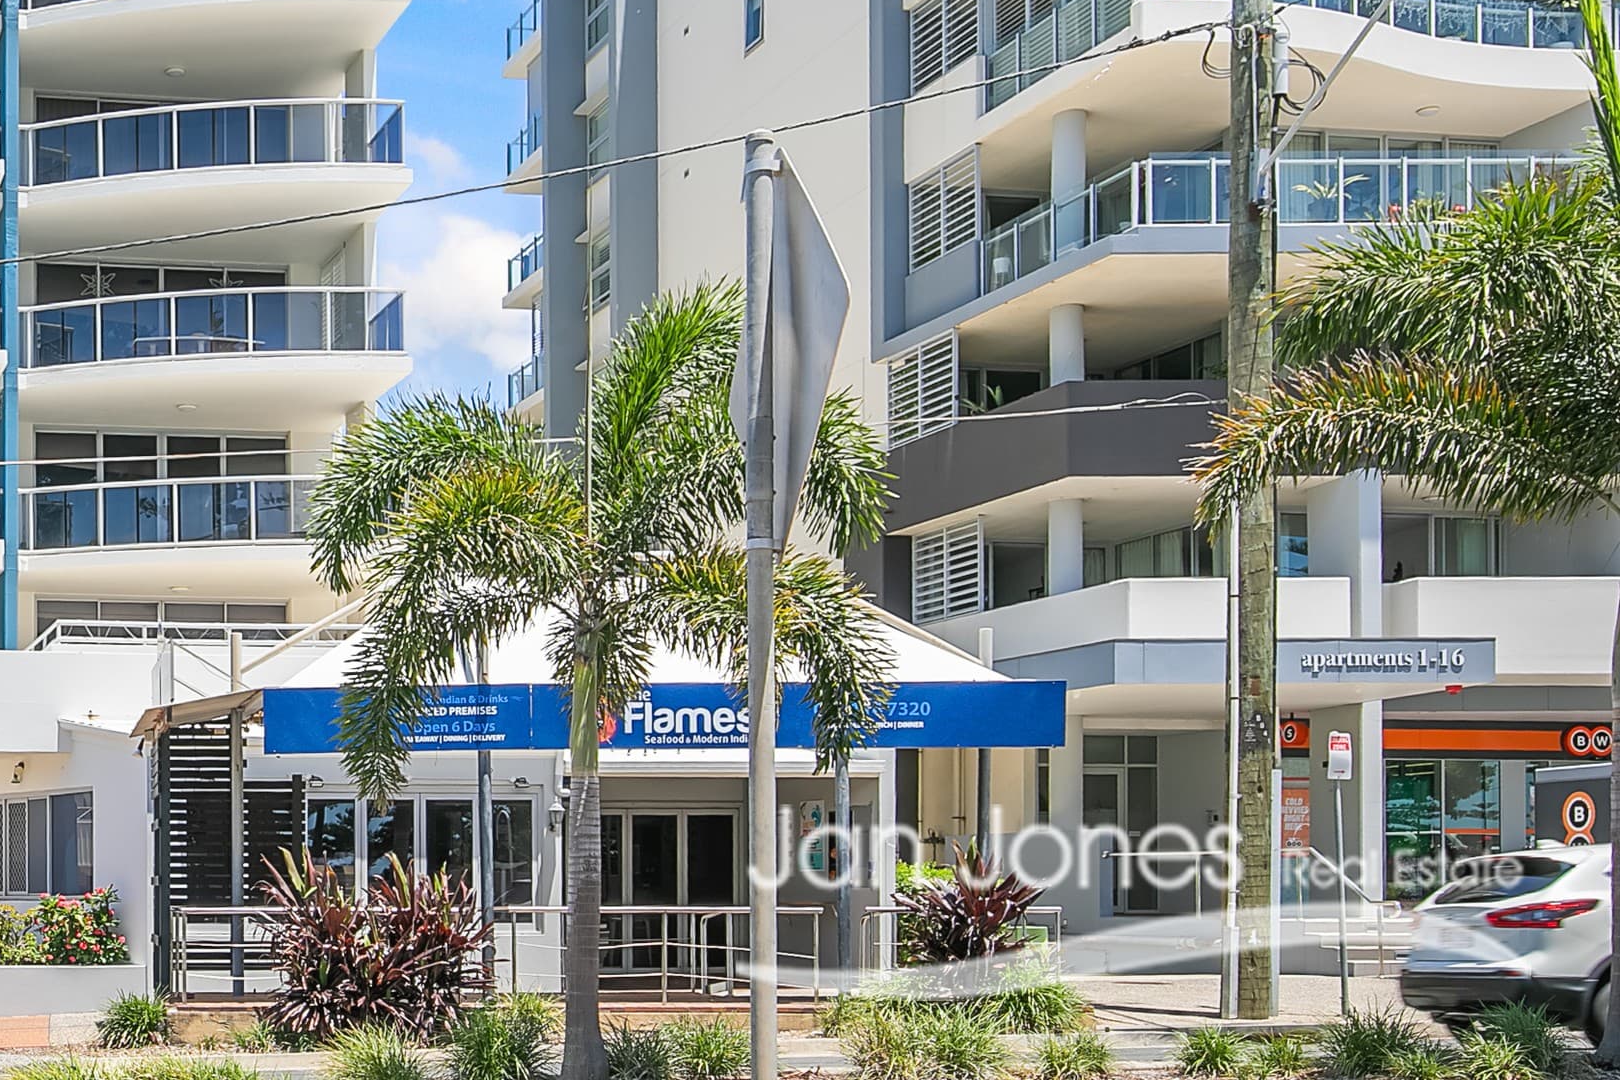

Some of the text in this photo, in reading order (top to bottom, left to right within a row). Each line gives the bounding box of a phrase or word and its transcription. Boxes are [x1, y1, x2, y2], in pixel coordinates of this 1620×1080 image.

[1302, 648, 1465, 672] apartments 1-16
[478, 694, 508, 703] Drinks
[449, 705, 498, 716] PREMISES
[452, 721, 461, 732] 6
[463, 720, 496, 734] Days
[472, 734, 506, 742] DELIVERY
[1286, 728, 1293, 738] S
[644, 734, 684, 744] Seafood
[692, 734, 729, 744] Modern
[730, 734, 749, 743] Indi
[1576, 735, 1609, 747] B W
[1573, 806, 1585, 822] B
